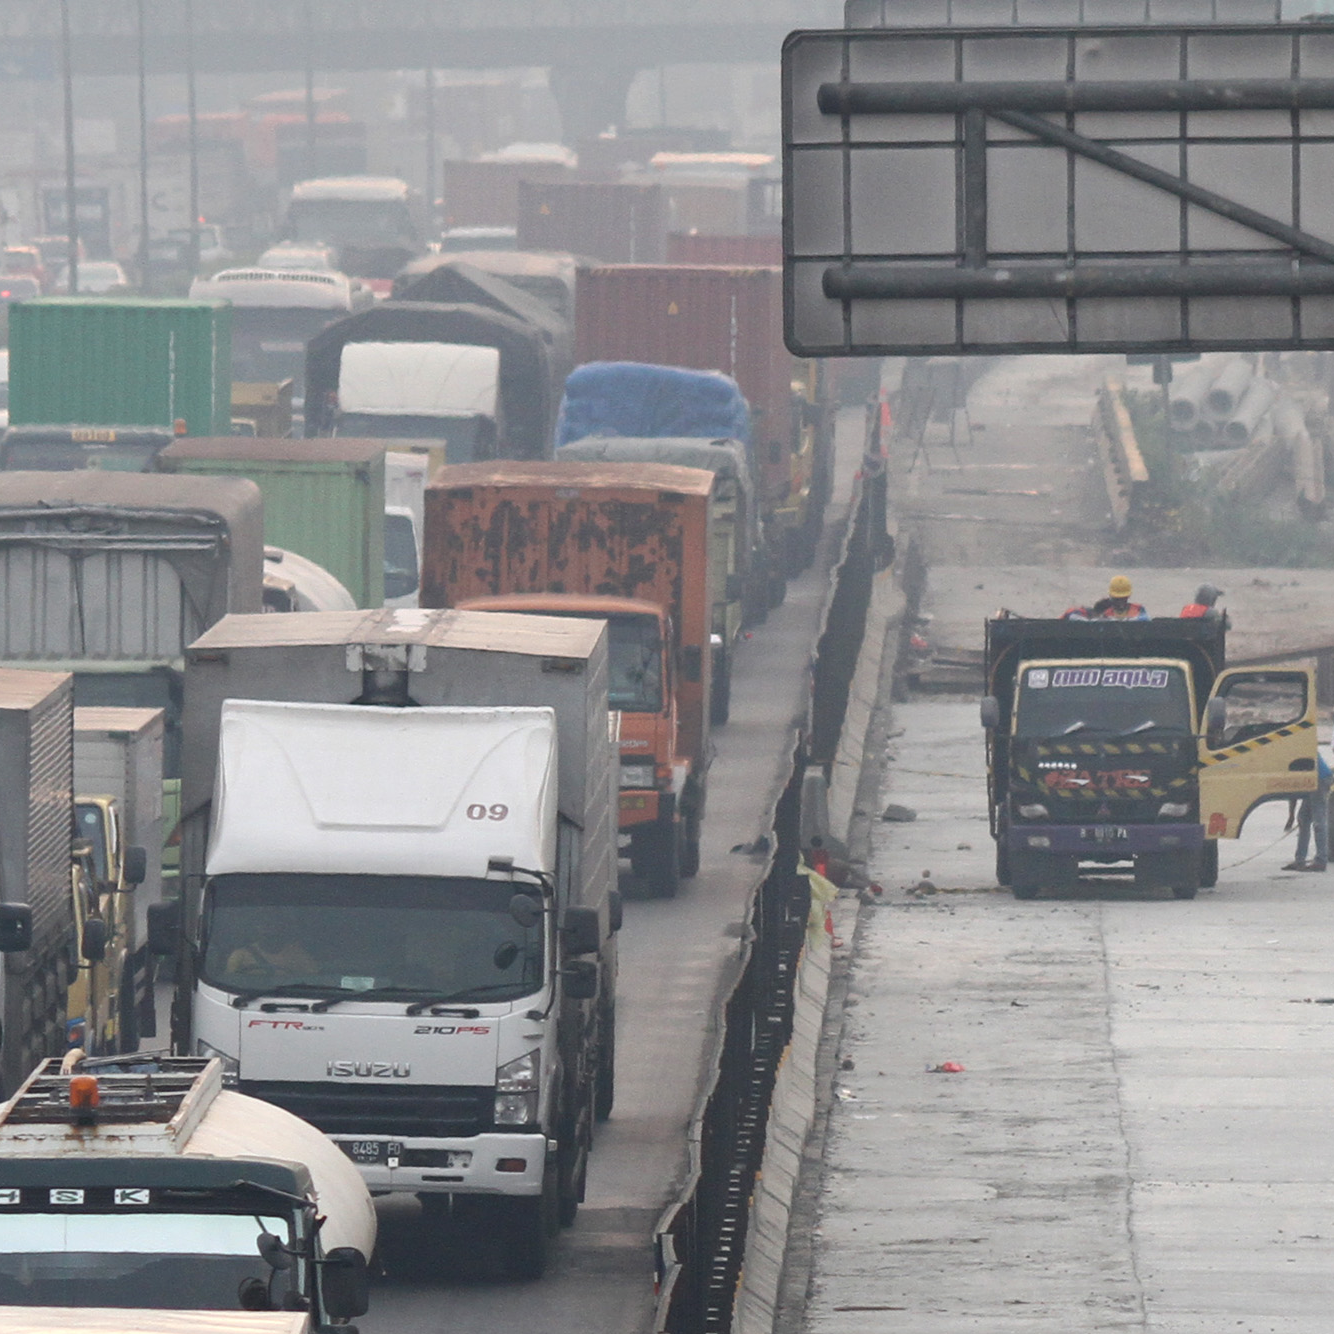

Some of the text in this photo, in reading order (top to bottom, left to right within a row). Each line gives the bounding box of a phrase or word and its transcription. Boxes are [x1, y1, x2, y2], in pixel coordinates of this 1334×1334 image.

[466, 803, 509, 821] 09
[247, 1019, 304, 1031] FTR
[413, 1025, 492, 1036] 210PS
[326, 1060, 412, 1079] ISUZU
[352, 1141, 380, 1156] 8485
